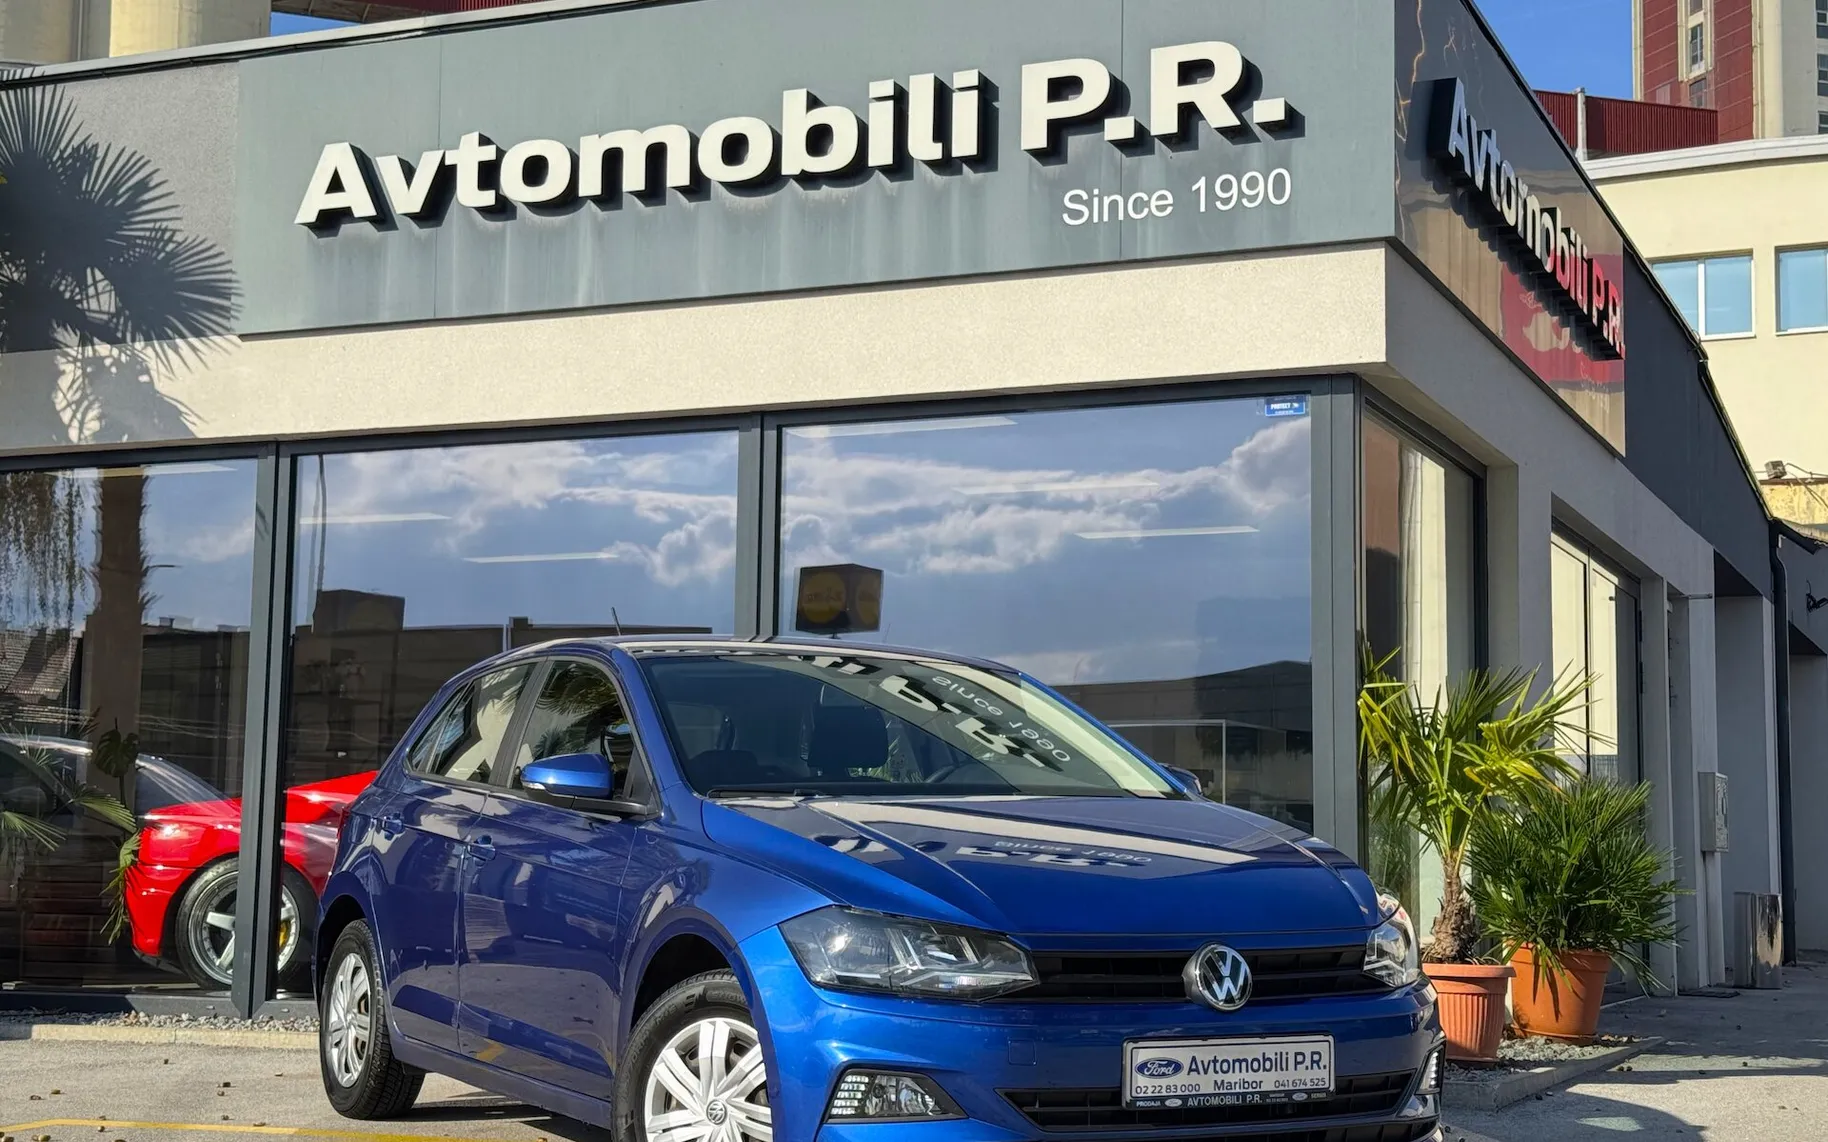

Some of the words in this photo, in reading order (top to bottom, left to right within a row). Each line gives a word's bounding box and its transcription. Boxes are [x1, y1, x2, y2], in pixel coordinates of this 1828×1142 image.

[294, 68, 979, 225] Avtomobili
[1021, 41, 1287, 151] P.R.
[1062, 184, 1174, 227] Since
[1191, 167, 1293, 212] 1990
[1448, 77, 1589, 315] Avtomobili
[1142, 1060, 1176, 1076] Ford
[1187, 1051, 1289, 1076] Avtomobili
[1293, 1050, 1327, 1072] P.R.
[1135, 1084, 1149, 1094] 02
[1150, 1084, 1164, 1094] 22
[1165, 1083, 1178, 1093] 83
[1180, 1083, 1201, 1093] 000
[1213, 1078, 1264, 1091] Maribor
[1274, 1079, 1290, 1088] 041
[1292, 1078, 1308, 1088] 674
[1309, 1077, 1327, 1087] 525
[1187, 1095, 1242, 1107] AVTOMOBILI
[1246, 1094, 1263, 1104] P.R.
